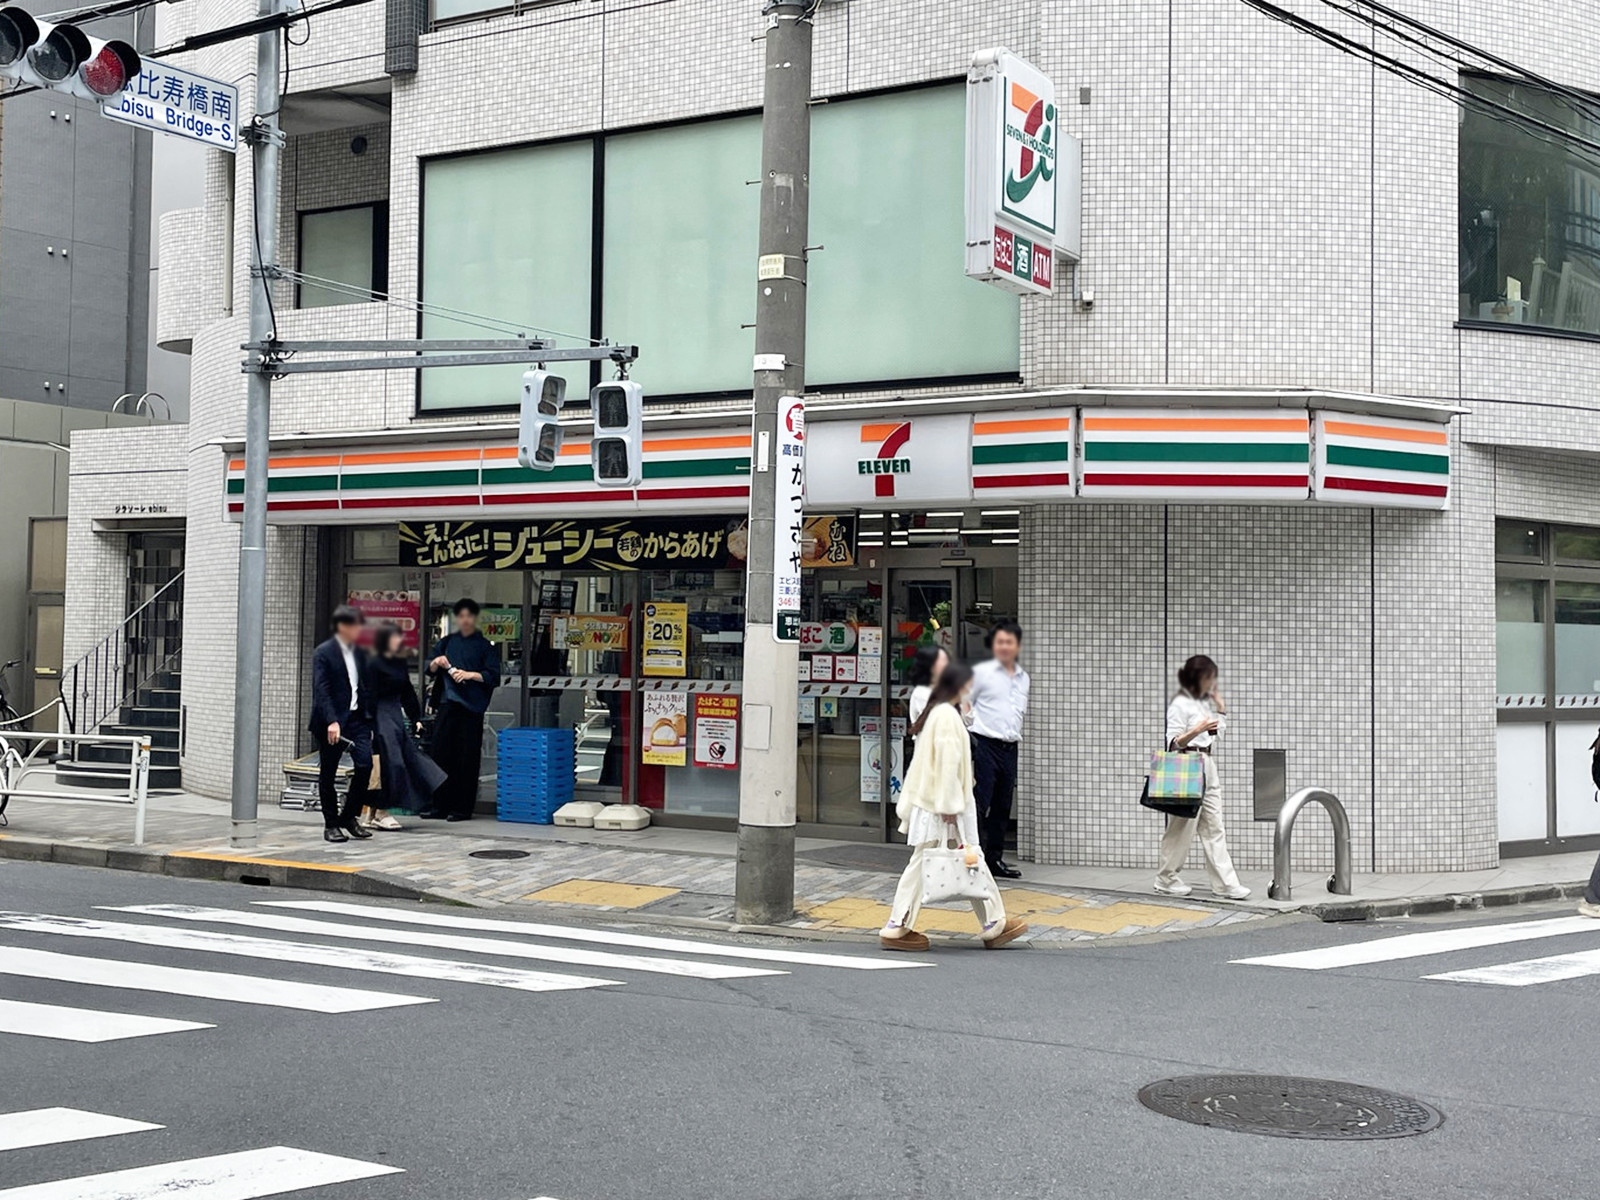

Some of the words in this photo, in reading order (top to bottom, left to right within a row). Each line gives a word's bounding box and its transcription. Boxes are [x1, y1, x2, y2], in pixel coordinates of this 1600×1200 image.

[124, 69, 231, 121] 比寿橋南
[112, 95, 154, 119] bisu
[166, 107, 234, 142] Bridge-S.
[1017, 243, 1029, 273] 酒
[1033, 251, 1050, 282] ATM
[643, 529, 725, 559] からあげ
[829, 521, 847, 562] むね
[829, 627, 845, 644] 酒
